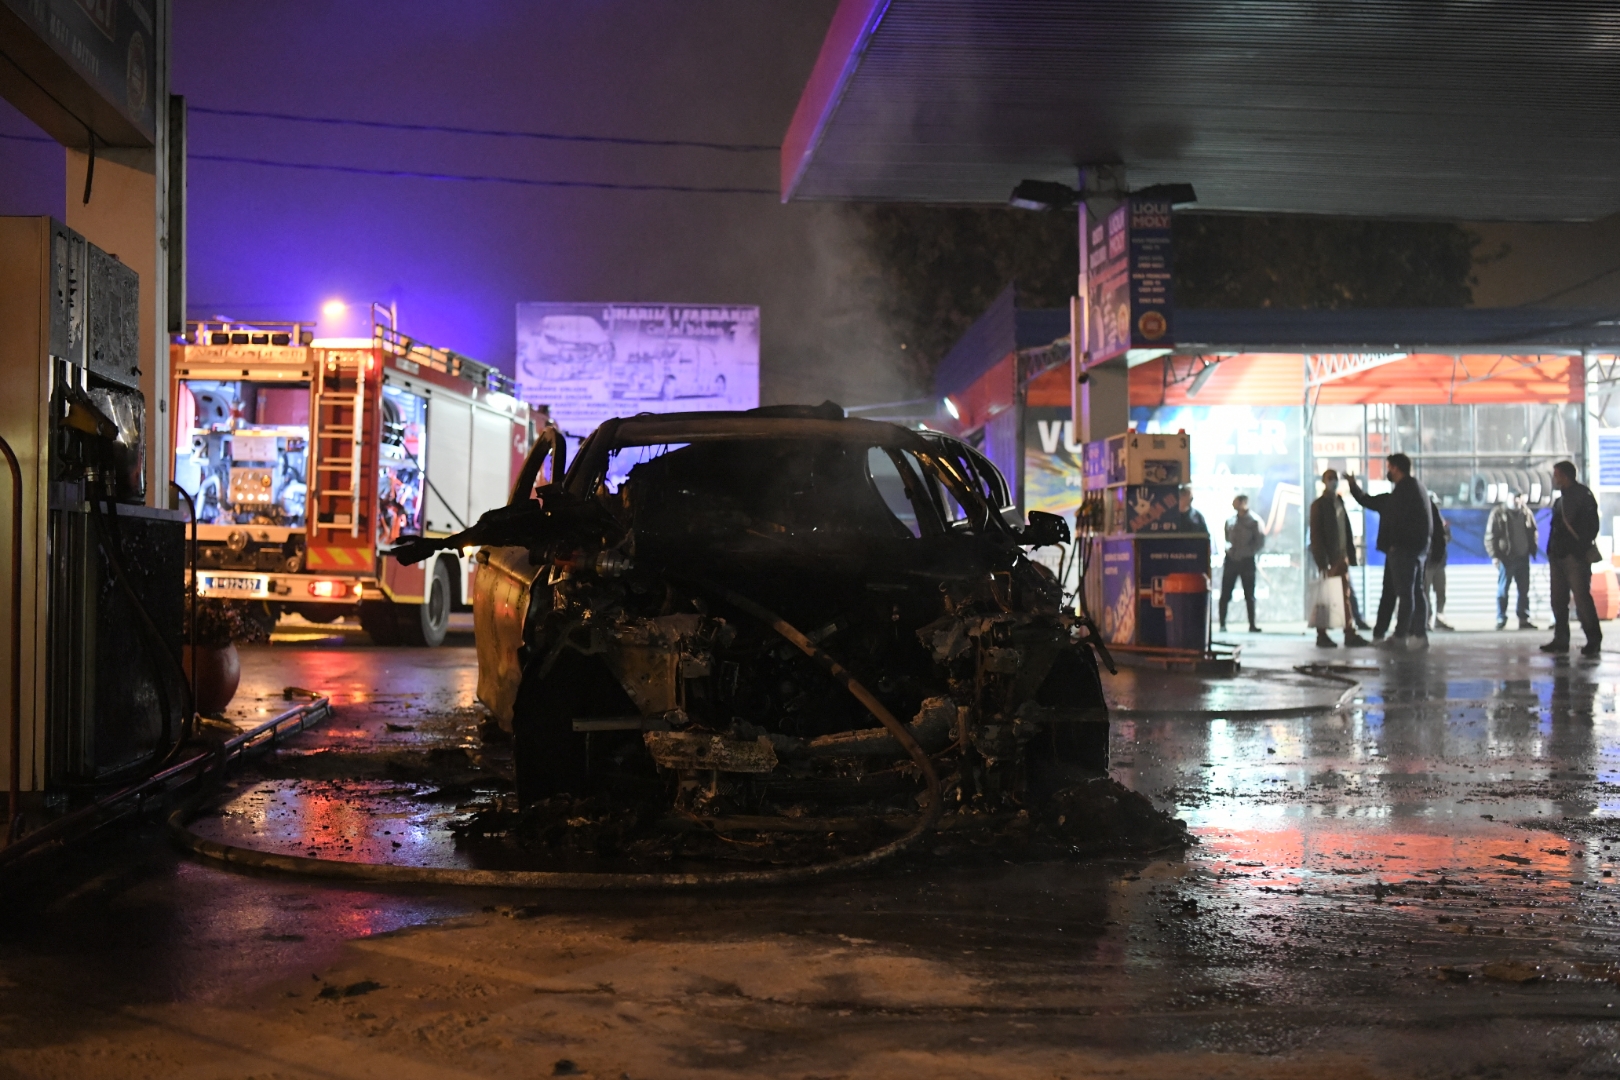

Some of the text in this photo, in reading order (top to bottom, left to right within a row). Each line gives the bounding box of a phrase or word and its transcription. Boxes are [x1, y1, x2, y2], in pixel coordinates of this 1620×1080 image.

[1133, 203, 1168, 215] LIQUI
[1133, 216, 1169, 227] MOLY
[1131, 438, 1138, 449] 4
[1180, 437, 1187, 448] 3
